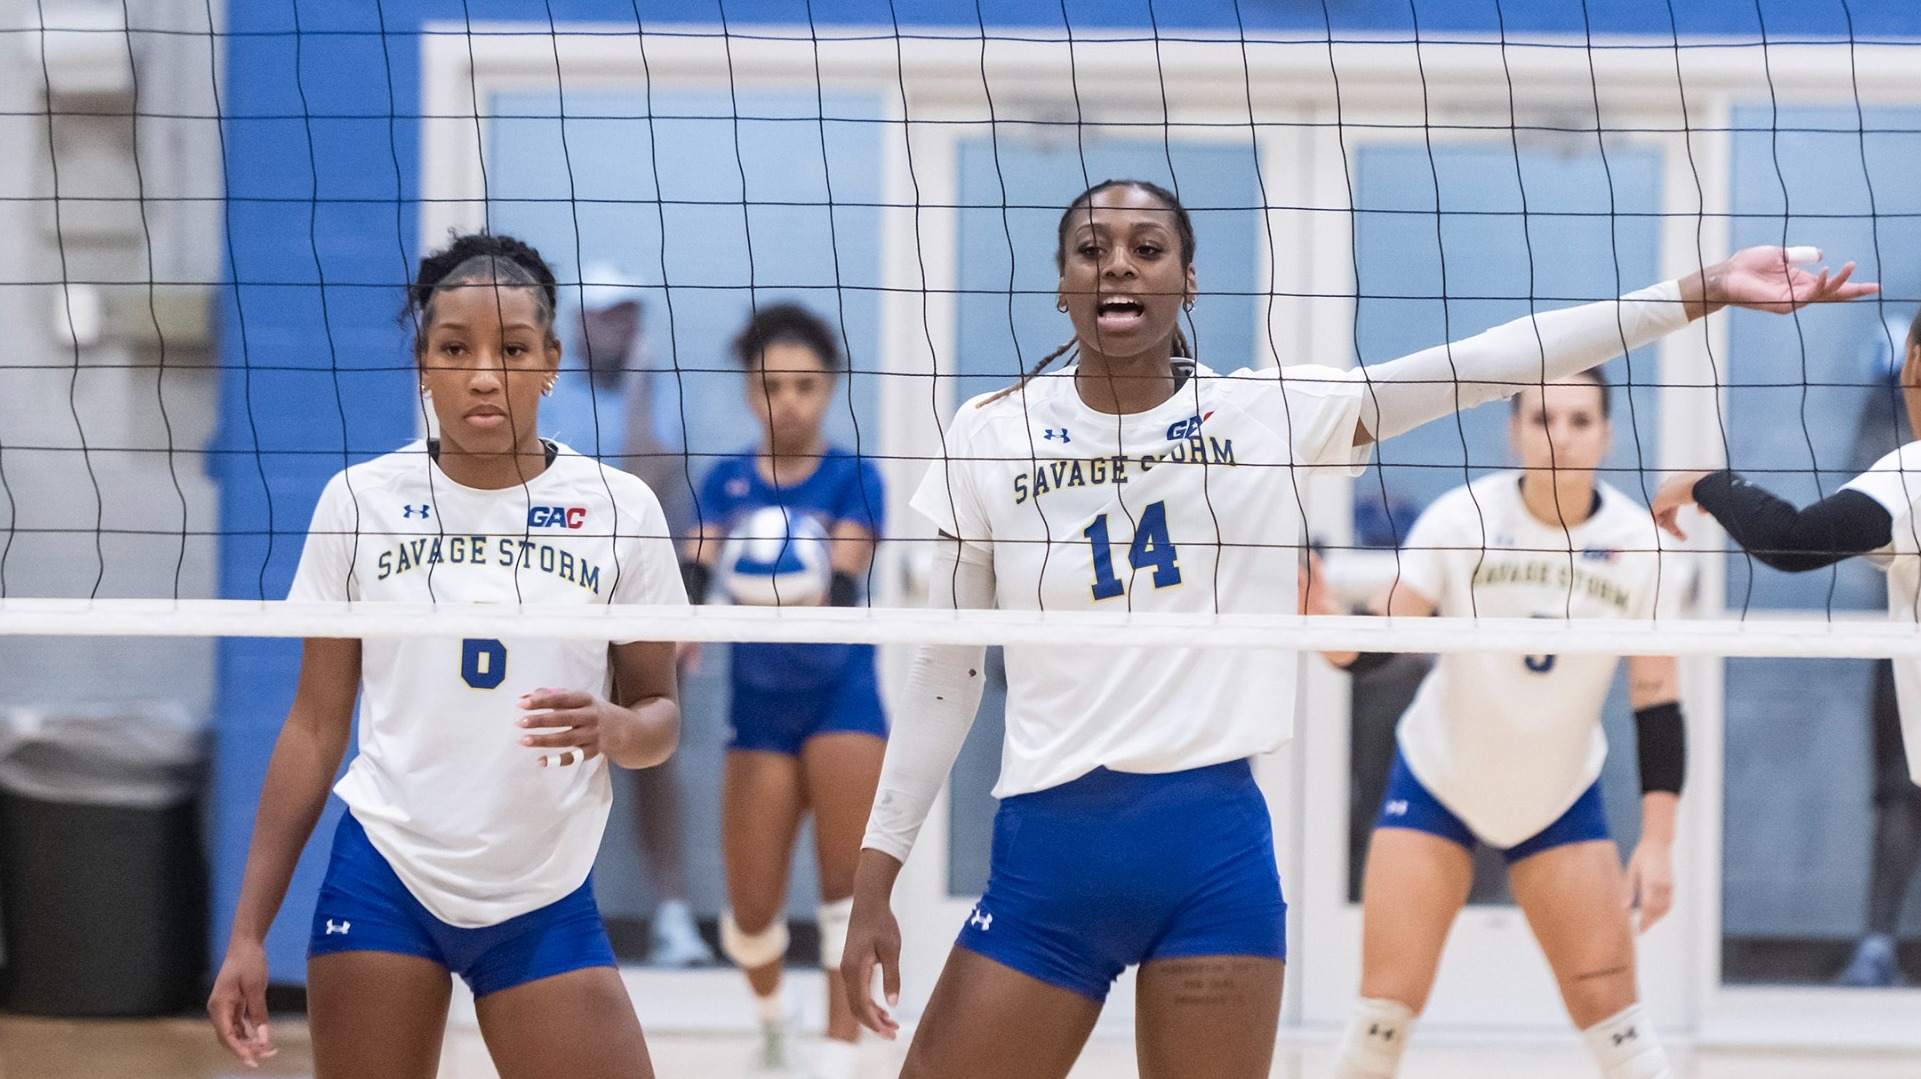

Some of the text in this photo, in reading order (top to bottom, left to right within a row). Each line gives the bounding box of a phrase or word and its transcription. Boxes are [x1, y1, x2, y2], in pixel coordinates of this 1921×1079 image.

[1013, 436, 1237, 505] SAVAGE SORM
[528, 506, 587, 529] GAC
[377, 536, 601, 595] SAVAGE STORM
[1083, 499, 1183, 603] 14
